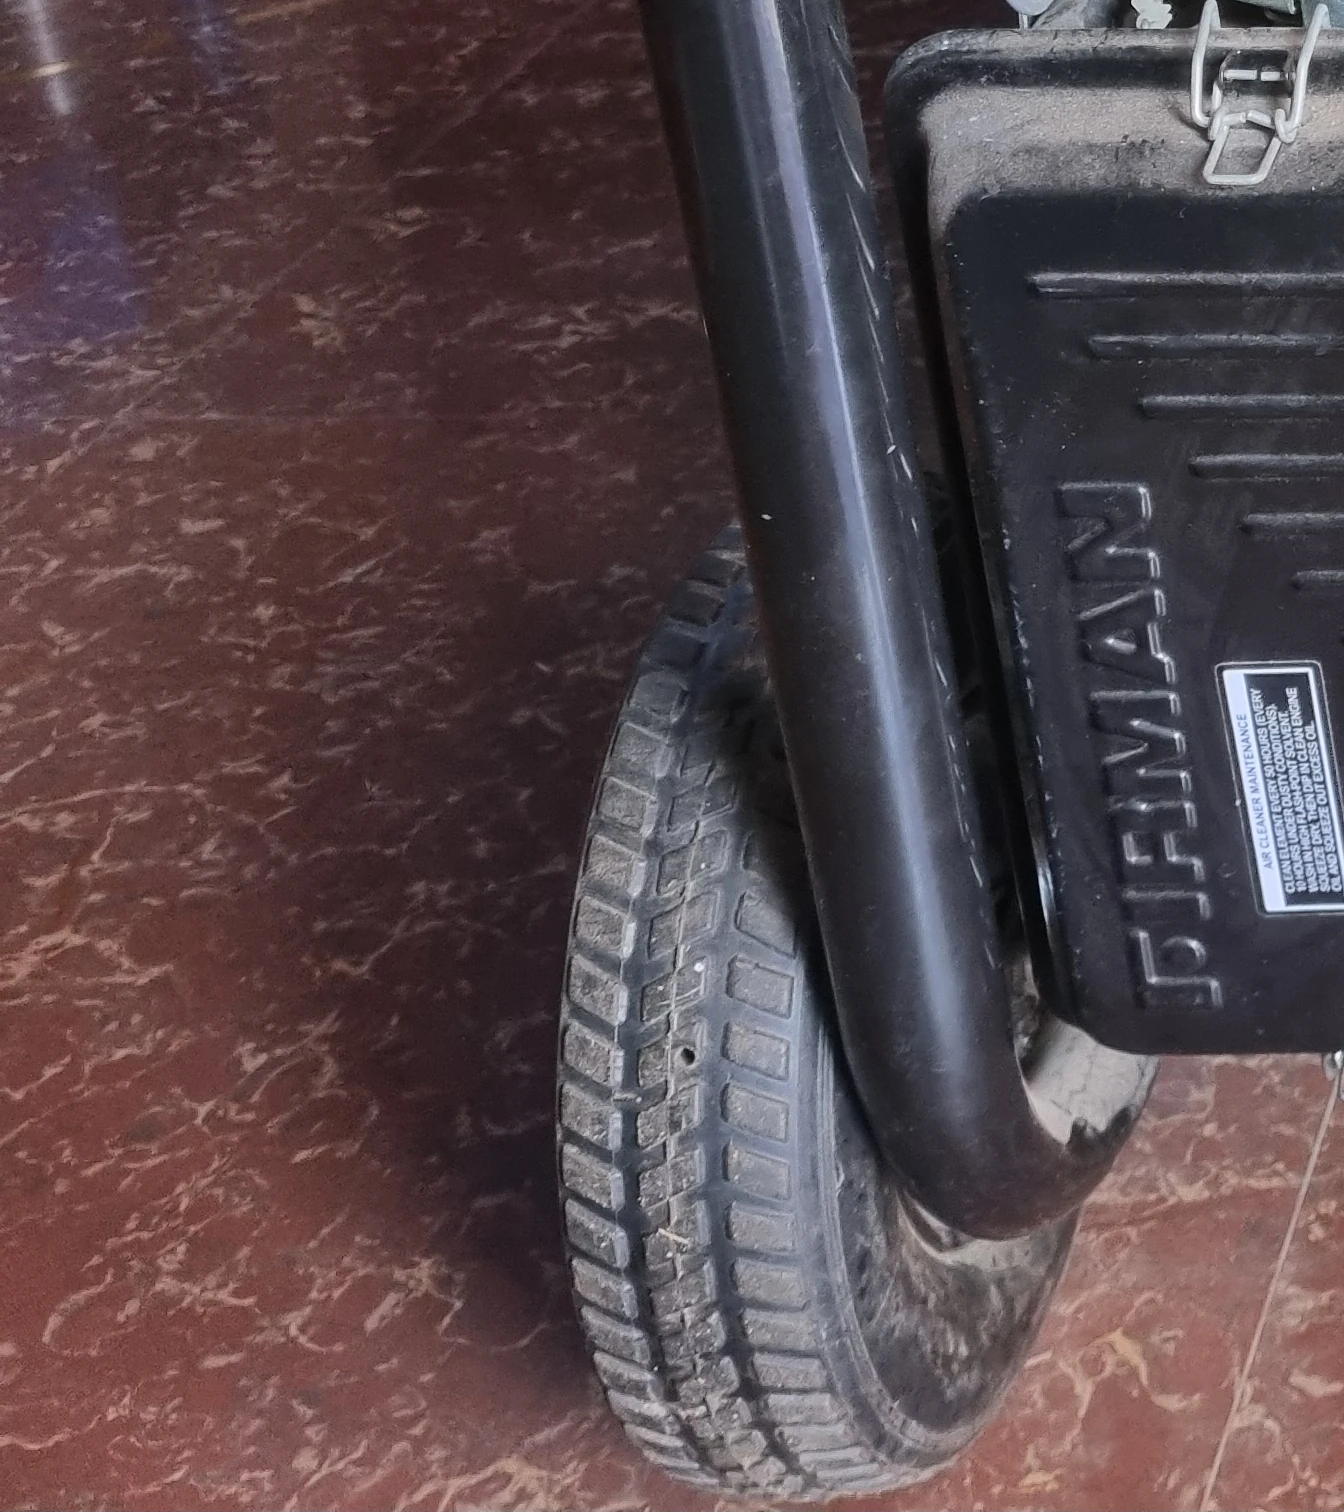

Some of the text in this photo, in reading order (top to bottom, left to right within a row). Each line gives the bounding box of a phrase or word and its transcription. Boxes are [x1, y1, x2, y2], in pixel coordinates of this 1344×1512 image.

[1286, 688, 1303, 726] ENGINE
[1058, 482, 1222, 1010] FIRMAN
[1278, 711, 1296, 758] SOLVENT.
[1293, 728, 1308, 761] CLEAN
[1307, 741, 1324, 782] EXCESS
[1236, 714, 1272, 869] AIR CLEANER MAINTENANCE
[1250, 688, 1295, 893] CLEAN ELEMENT EVERY 50 HOURS (EVERY
[1265, 704, 1307, 892] 10 HOURS UNDER DUSTY CONDITIONS).
[1286, 760, 1307, 824] FLASH-POINT
[1301, 775, 1314, 793] DIP
[1314, 783, 1327, 805] OUT
[1304, 794, 1318, 821] THEN
[1298, 825, 1311, 850] HIGH
[1318, 807, 1335, 852] SQUEEZE
[1304, 863, 1319, 893] WASH
[1313, 846, 1331, 892] SQUEEZE
[1326, 853, 1339, 875] AND
[1331, 876, 1342, 892] OIL
